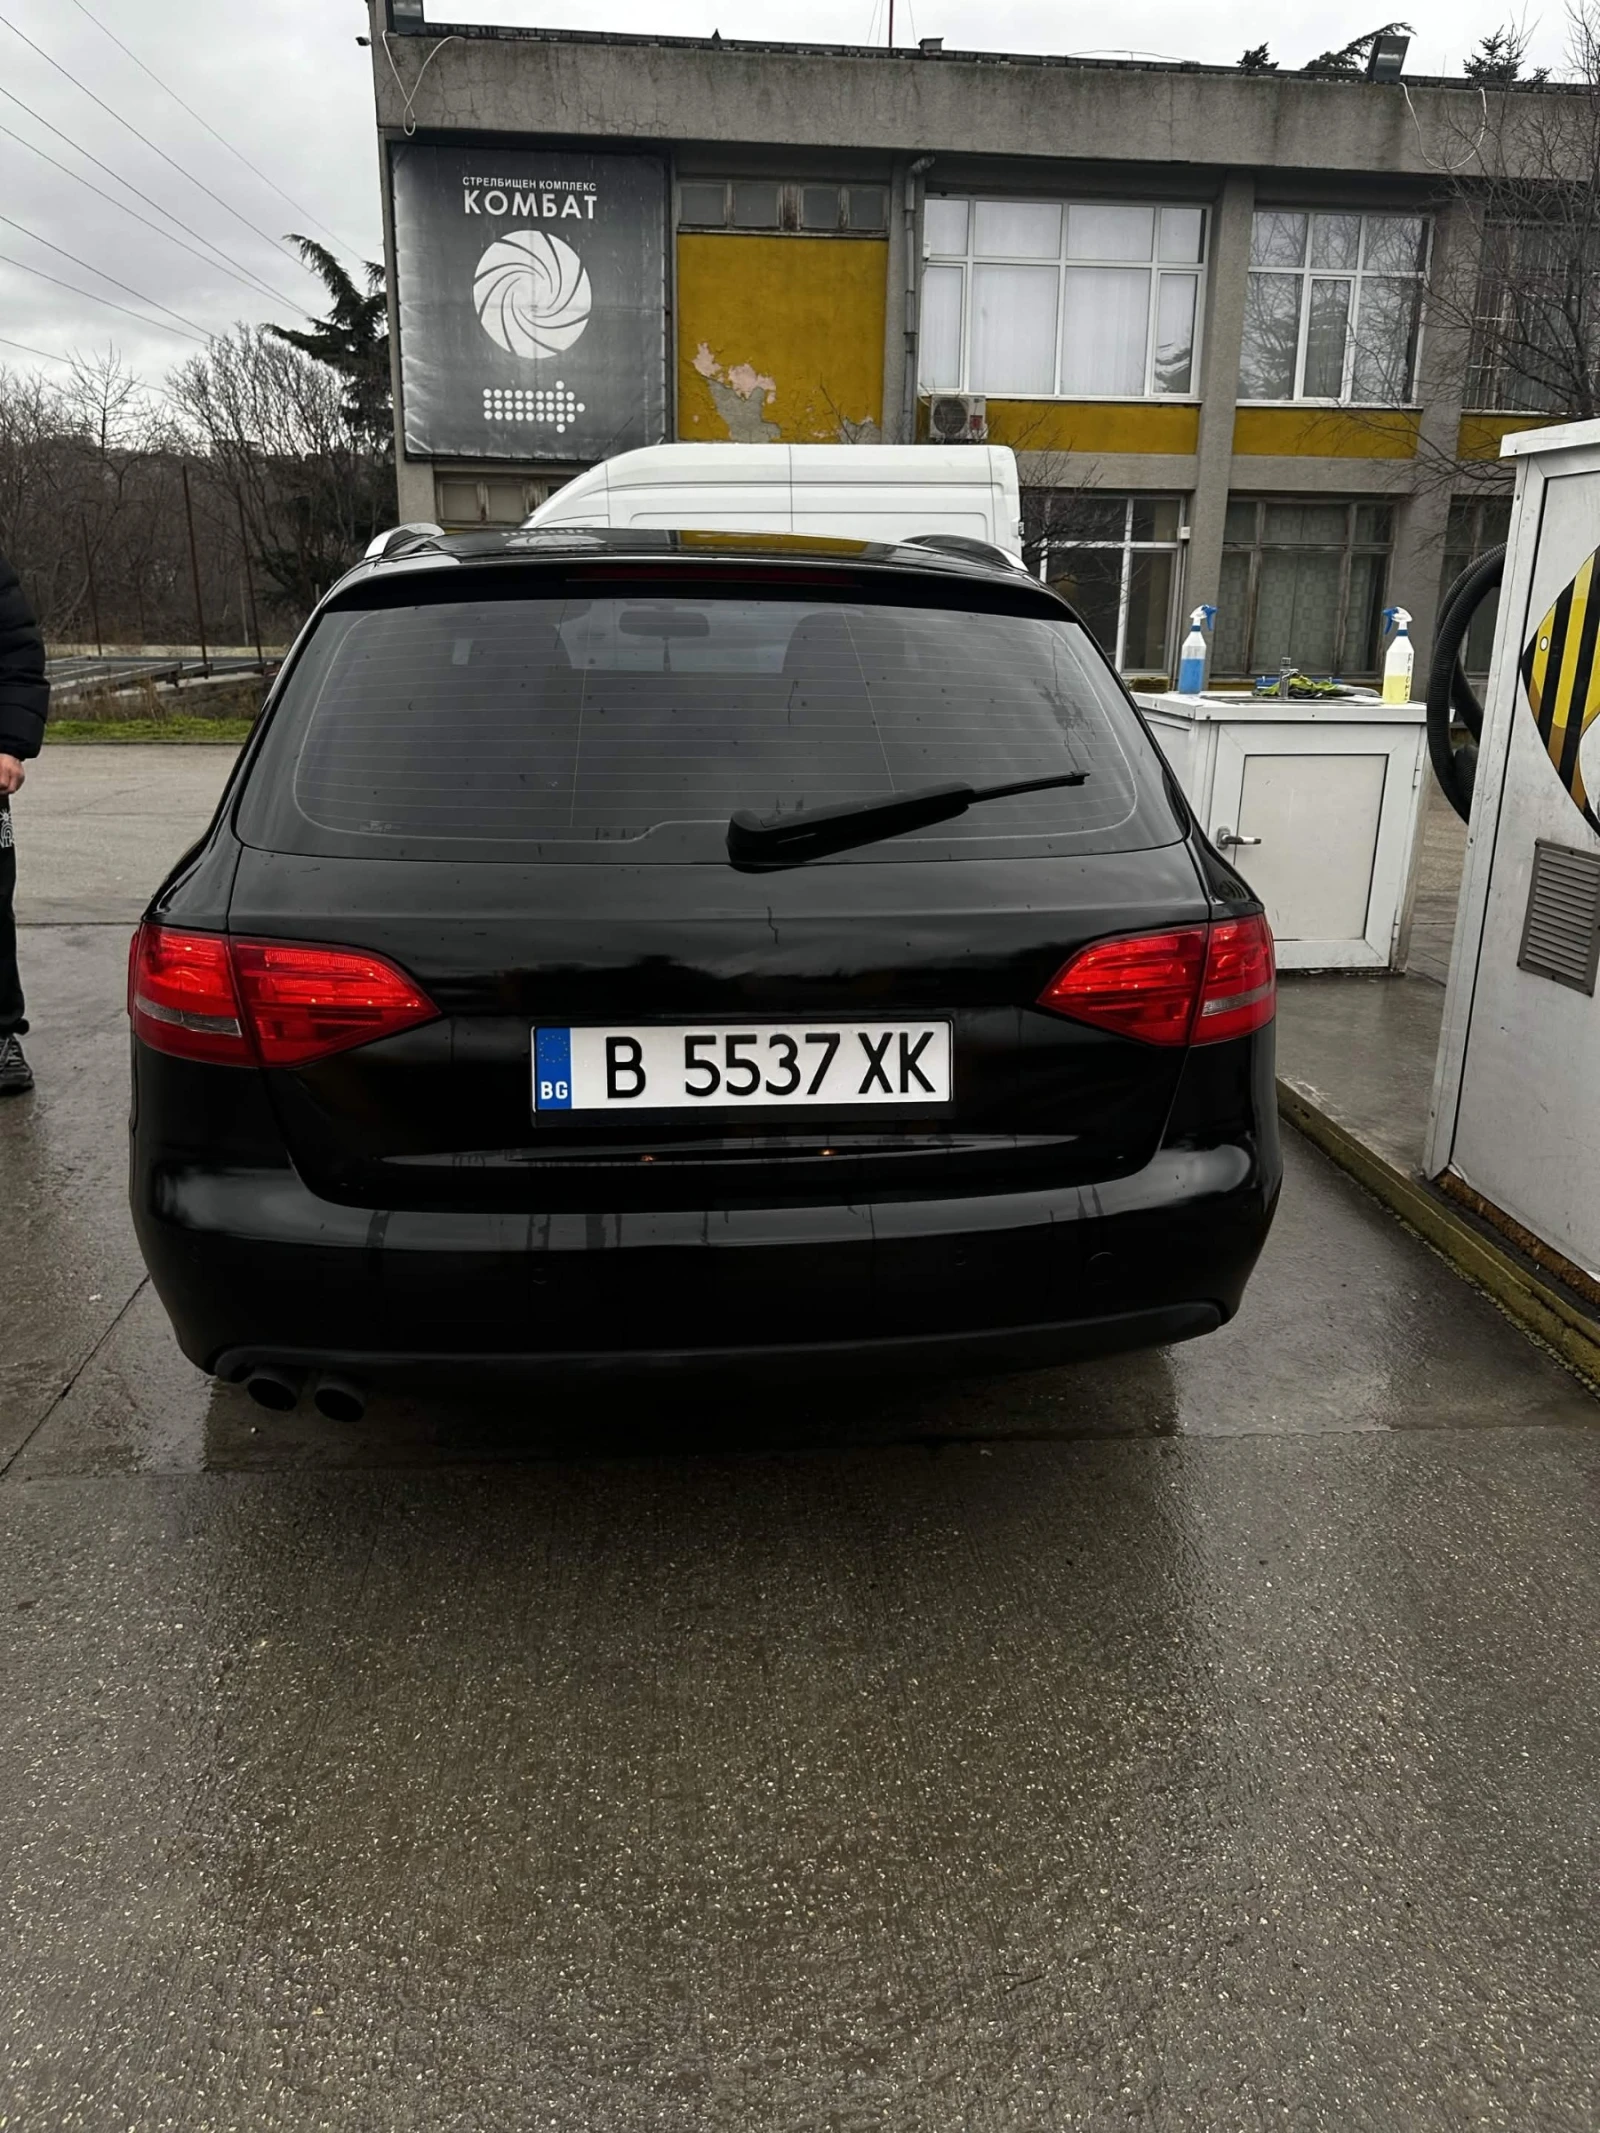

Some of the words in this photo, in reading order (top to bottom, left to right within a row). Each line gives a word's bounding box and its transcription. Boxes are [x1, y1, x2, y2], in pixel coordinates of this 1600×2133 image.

[462, 176, 537, 189] СТРЕЛБИЩЕН
[539, 180, 597, 192] КОМПЛЕКС
[464, 189, 598, 219] КОМБАТ
[605, 1036, 646, 1099] B
[684, 1033, 841, 1097] 5537
[857, 1031, 937, 1095] XK
[541, 1081, 568, 1100] BG
